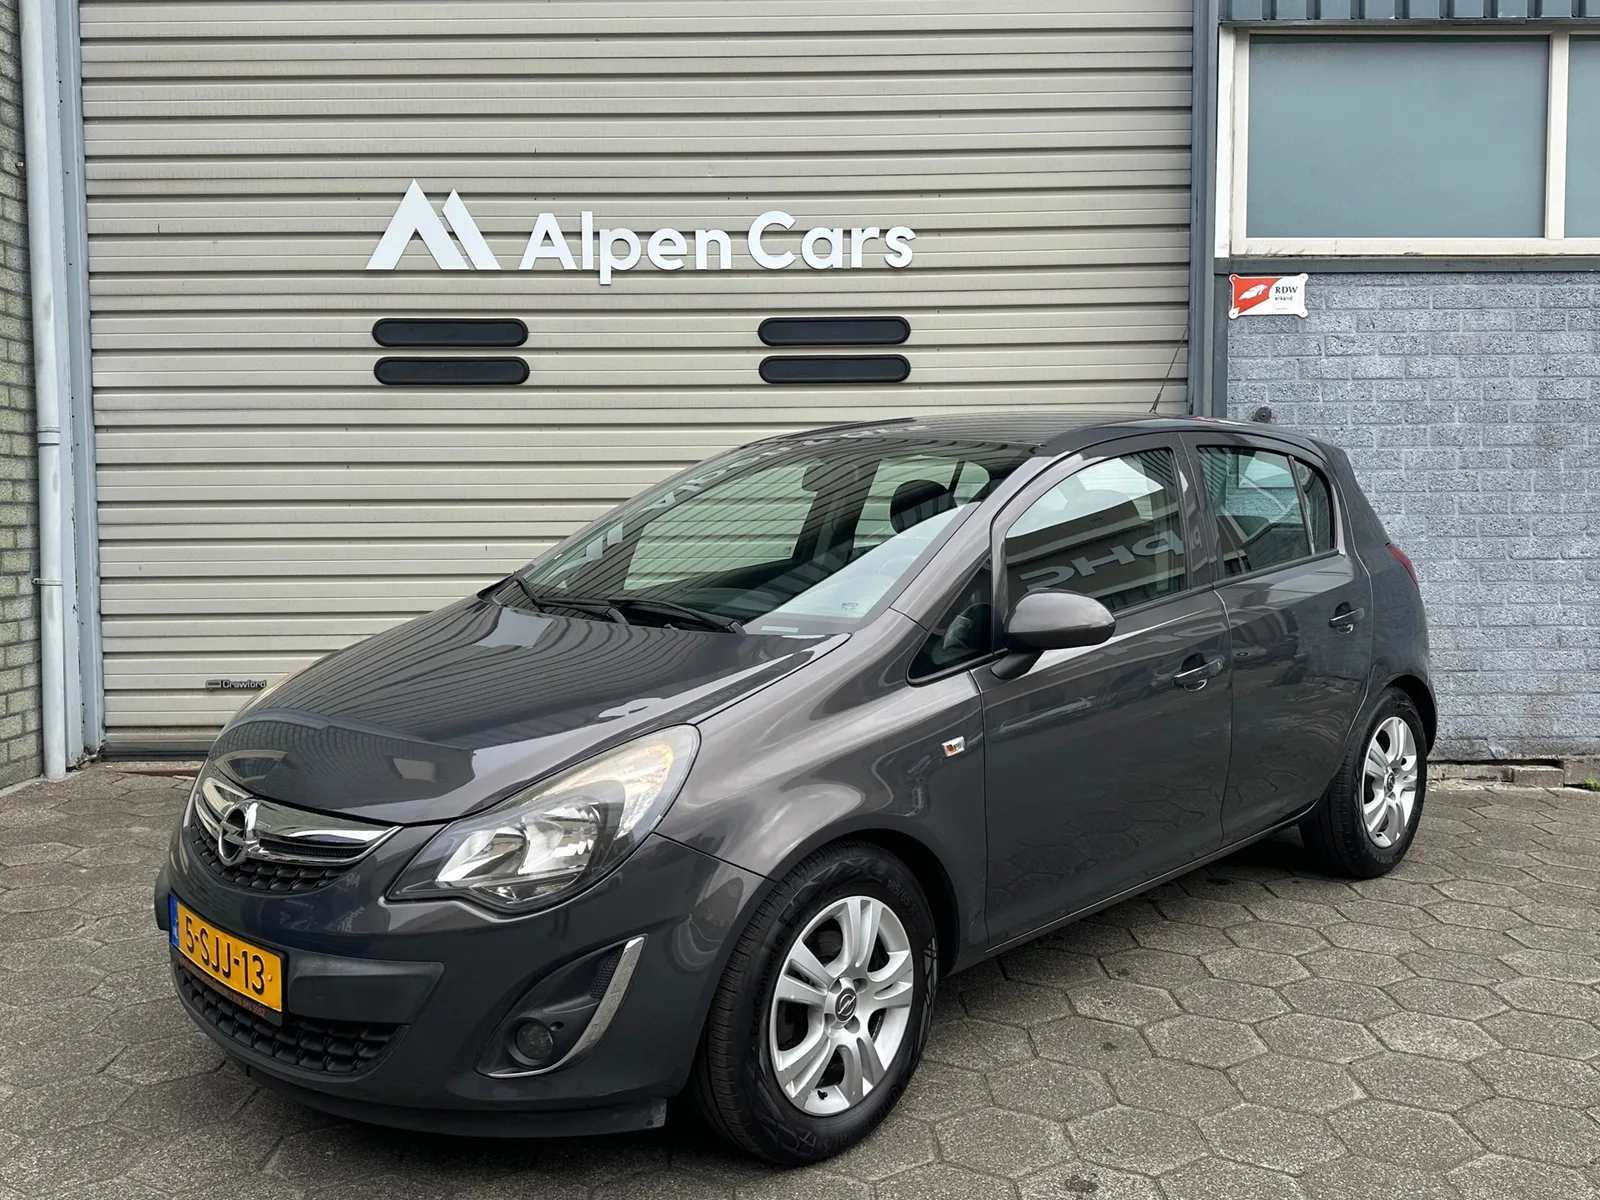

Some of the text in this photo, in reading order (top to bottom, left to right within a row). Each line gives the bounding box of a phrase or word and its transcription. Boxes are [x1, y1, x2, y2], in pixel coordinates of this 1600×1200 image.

[518, 210, 916, 285] Alpen Cars
[1275, 286, 1298, 294] RDW
[222, 680, 267, 689] Crawford
[886, 878, 913, 906] 185/65
[185, 915, 265, 995] 5-SJJ-13
